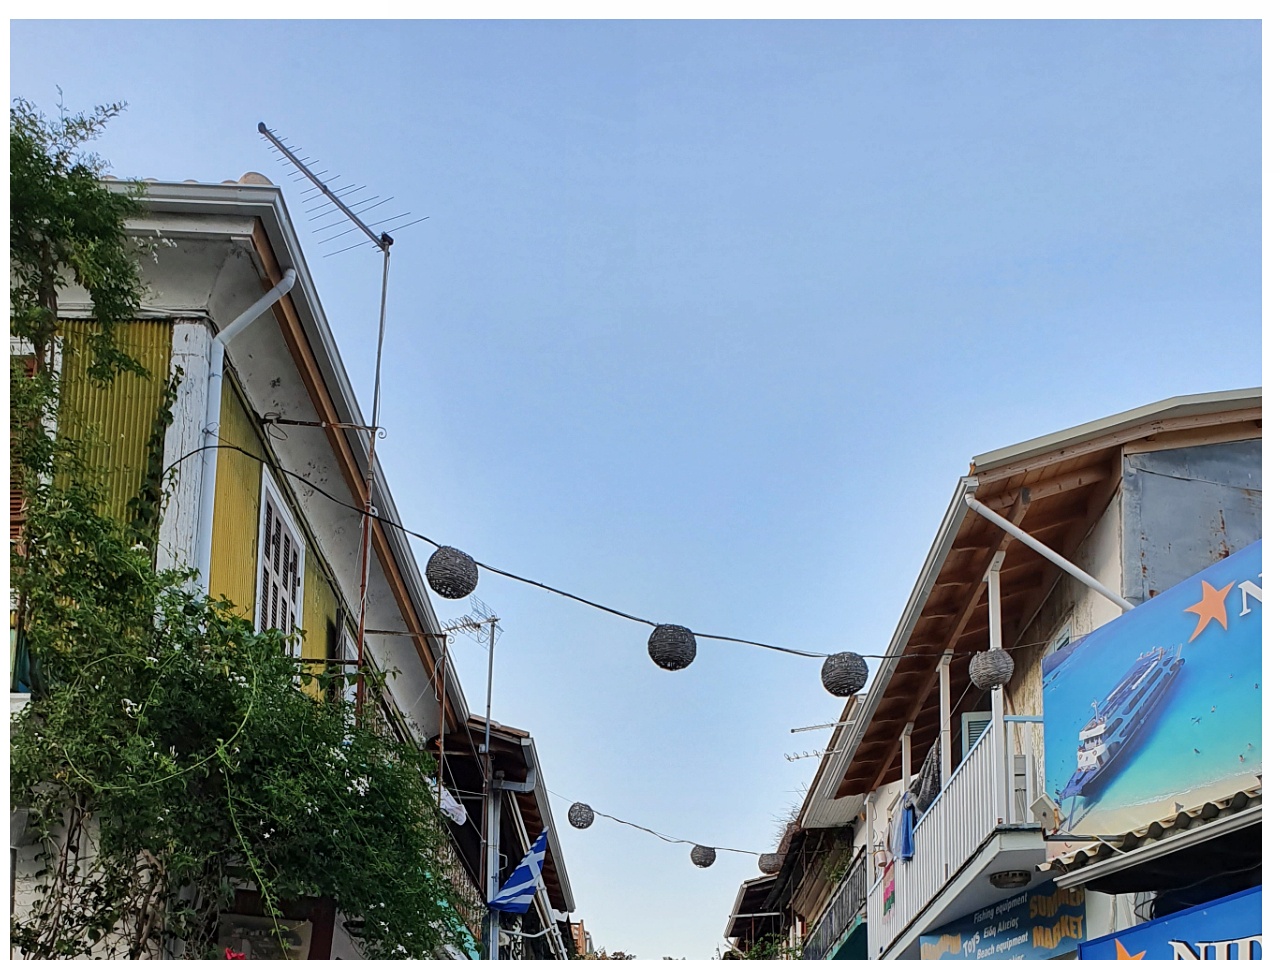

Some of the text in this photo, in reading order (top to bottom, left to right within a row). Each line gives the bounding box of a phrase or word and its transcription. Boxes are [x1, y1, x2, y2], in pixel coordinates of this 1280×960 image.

[973, 892, 1028, 924] Fishing equipment
[976, 944, 995, 960] Beach
[995, 930, 1028, 953] equipment
[1032, 914, 1084, 949] MARKET
